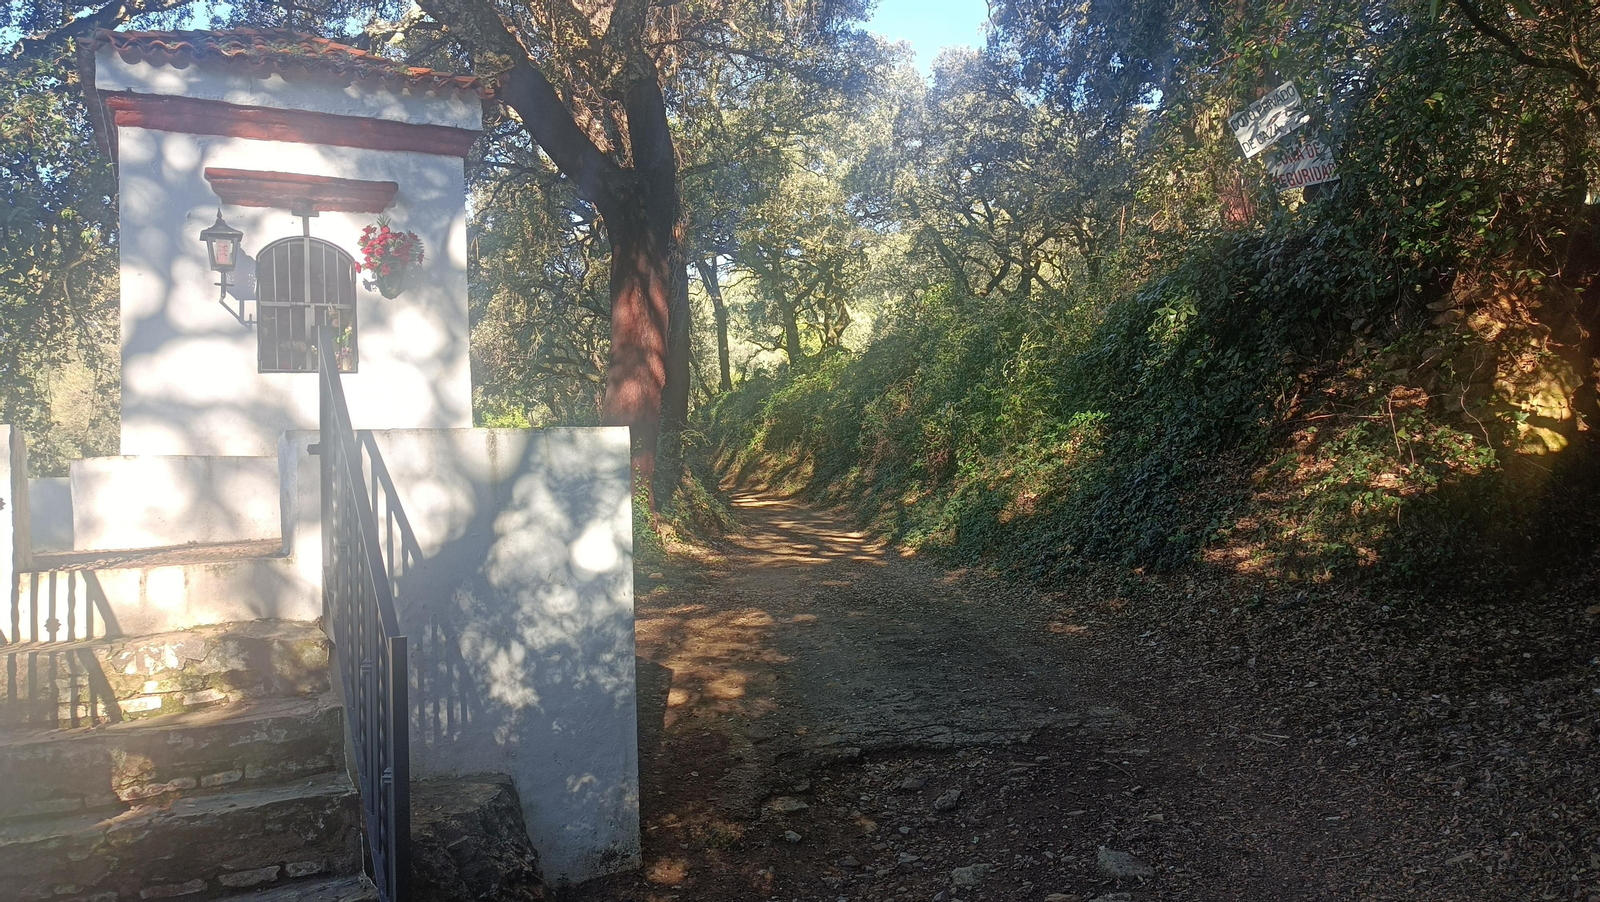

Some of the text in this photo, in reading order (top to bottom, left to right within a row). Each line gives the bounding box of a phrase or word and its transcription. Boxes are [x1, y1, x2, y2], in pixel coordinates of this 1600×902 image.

[1230, 85, 1296, 131] COTO PRIVADO
[1241, 123, 1282, 154] DE CAZA
[1276, 142, 1320, 168] ONA DE
[1272, 163, 1336, 187] EGURIDAD
